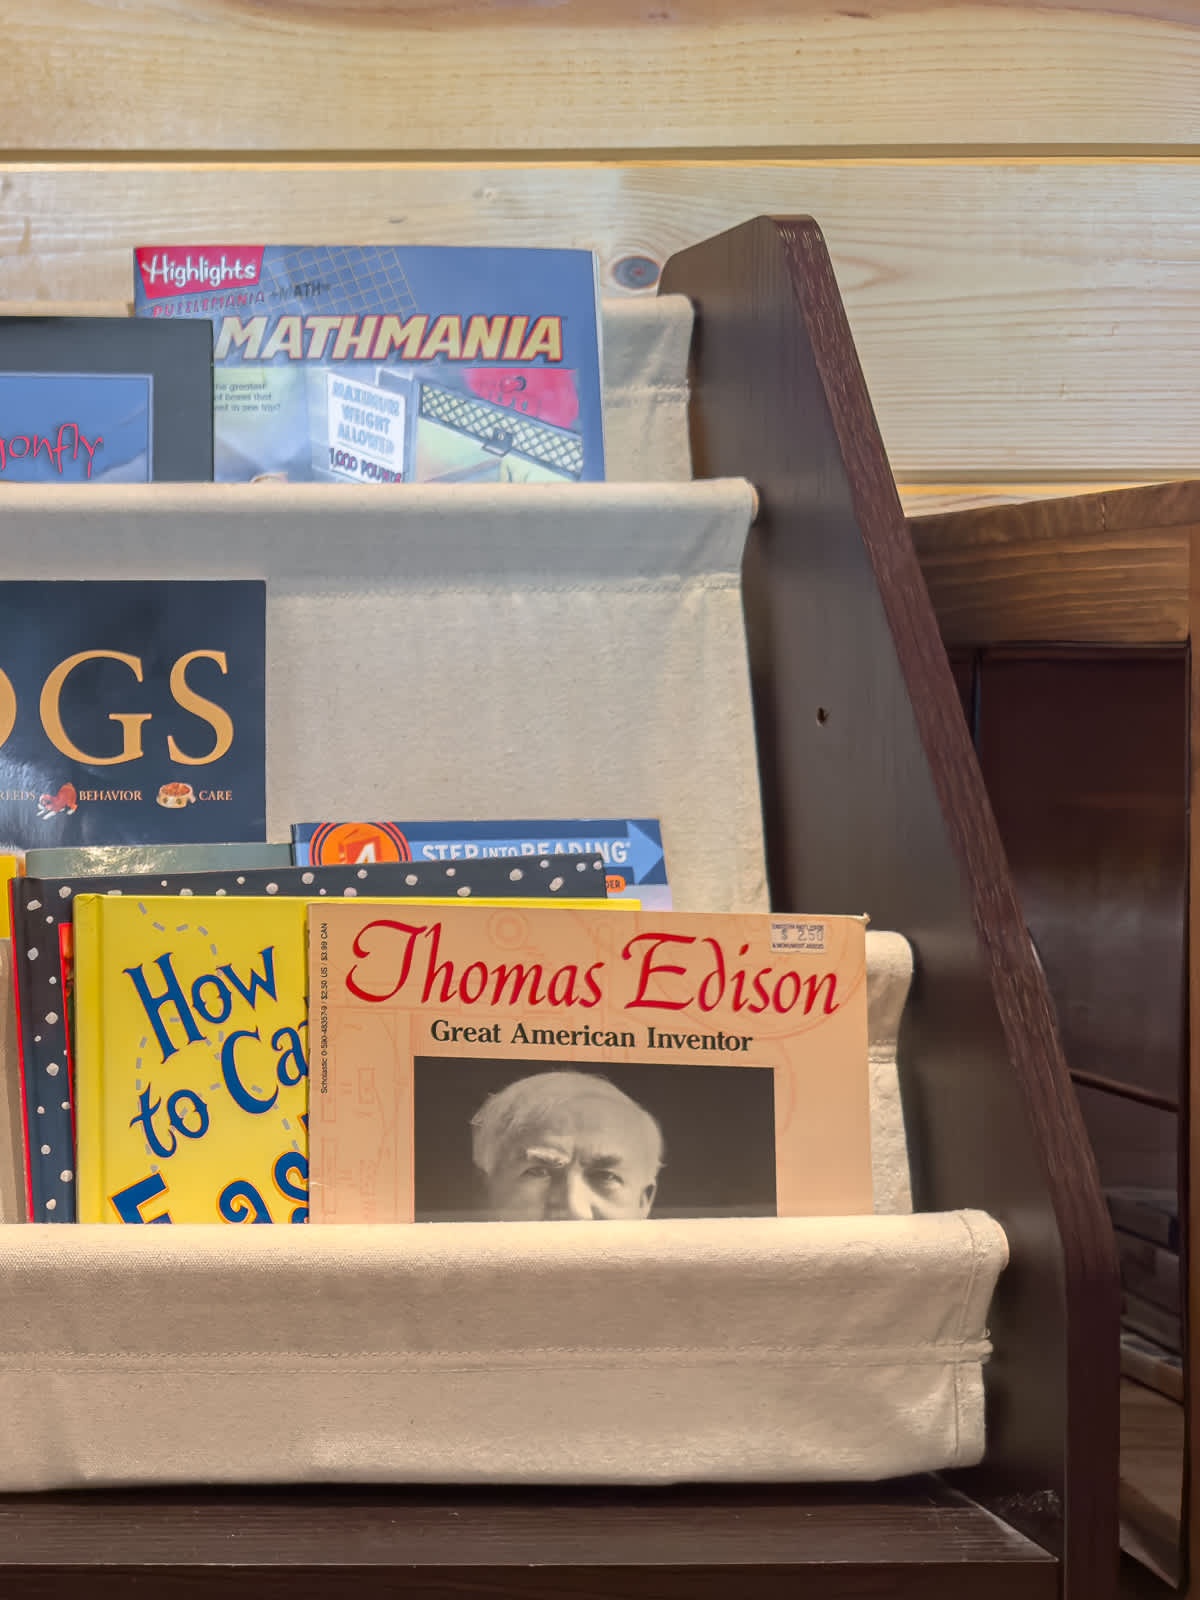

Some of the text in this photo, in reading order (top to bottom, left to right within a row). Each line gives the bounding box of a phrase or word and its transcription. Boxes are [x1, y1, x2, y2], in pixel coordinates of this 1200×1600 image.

[142, 253, 257, 288] Highlights
[214, 315, 565, 362] MATHMANIA
[341, 403, 391, 436] WEIGHT
[79, 789, 143, 801] BEHAVIOR
[199, 789, 233, 801] CARE
[422, 844, 478, 862] STEP
[483, 847, 519, 858] INTO
[320, 922, 328, 940] CAN
[345, 919, 840, 1016] Thomas Edison
[122, 945, 279, 1064] How
[430, 1018, 754, 1051] Great American Inventor
[129, 1081, 211, 1159] to
